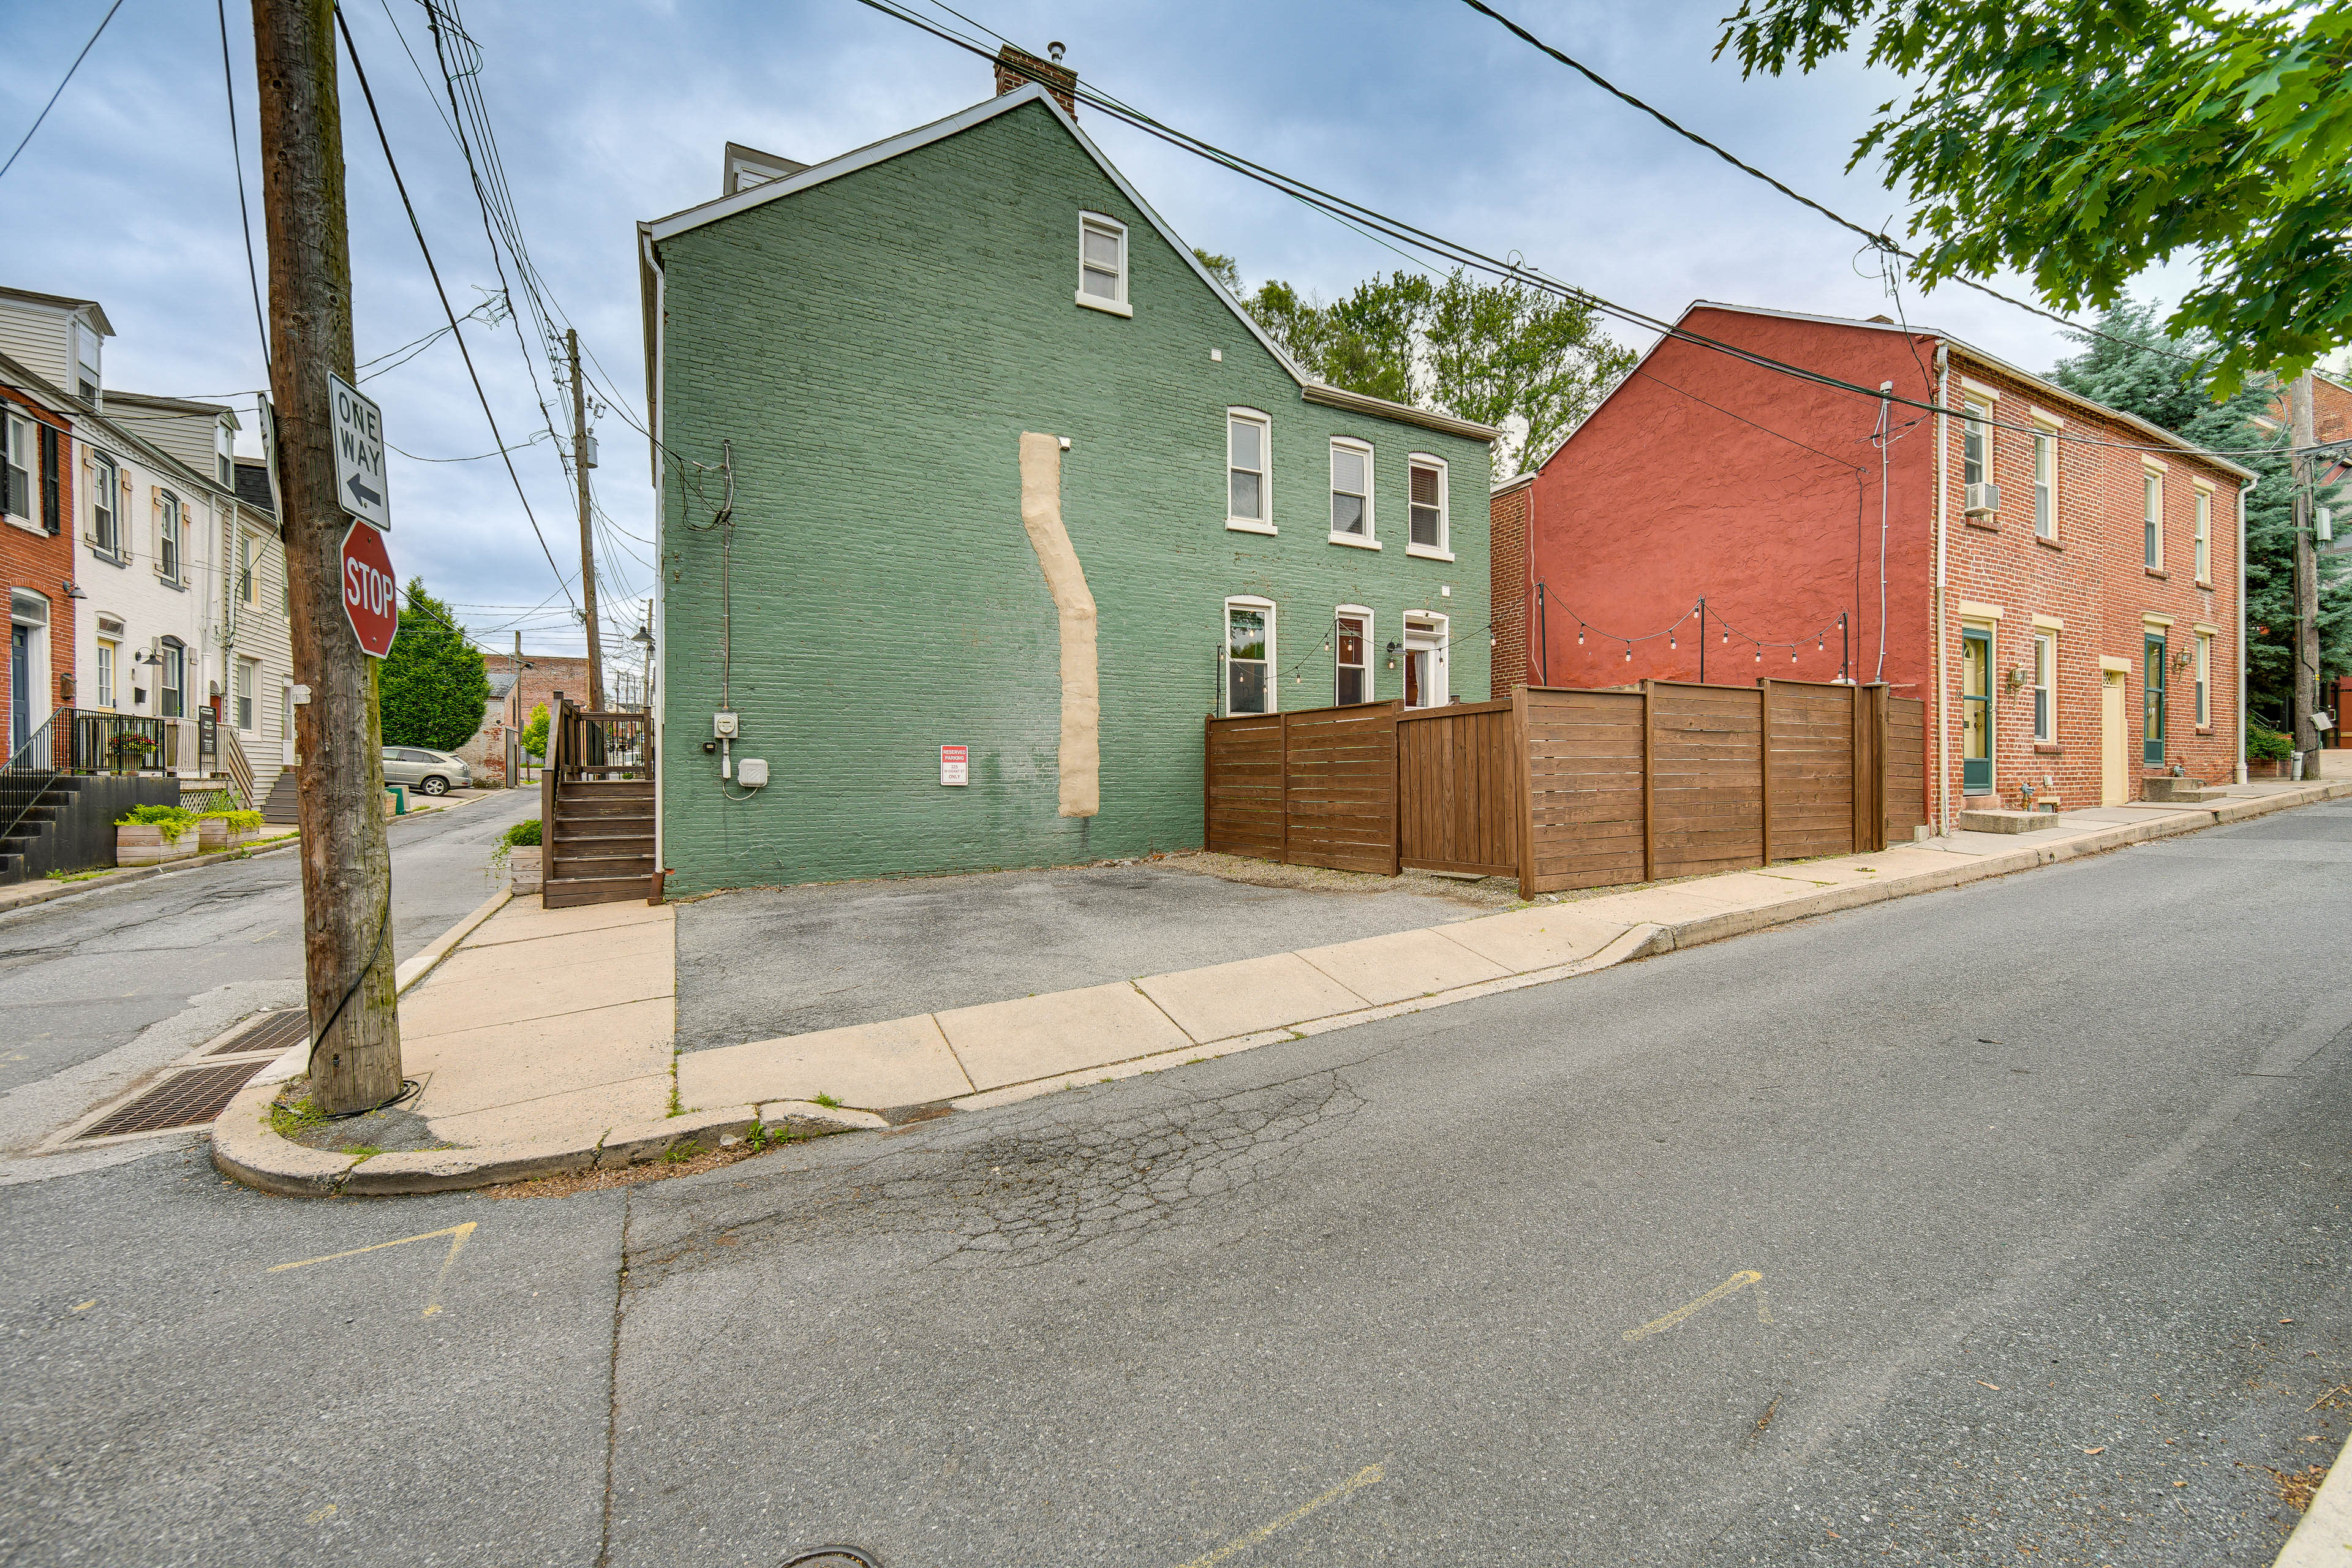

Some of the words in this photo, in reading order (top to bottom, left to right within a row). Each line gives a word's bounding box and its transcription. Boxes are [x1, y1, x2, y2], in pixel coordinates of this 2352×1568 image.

[339, 391, 379, 443] ONE
[339, 426, 380, 477] WAY
[347, 556, 394, 619] STOP
